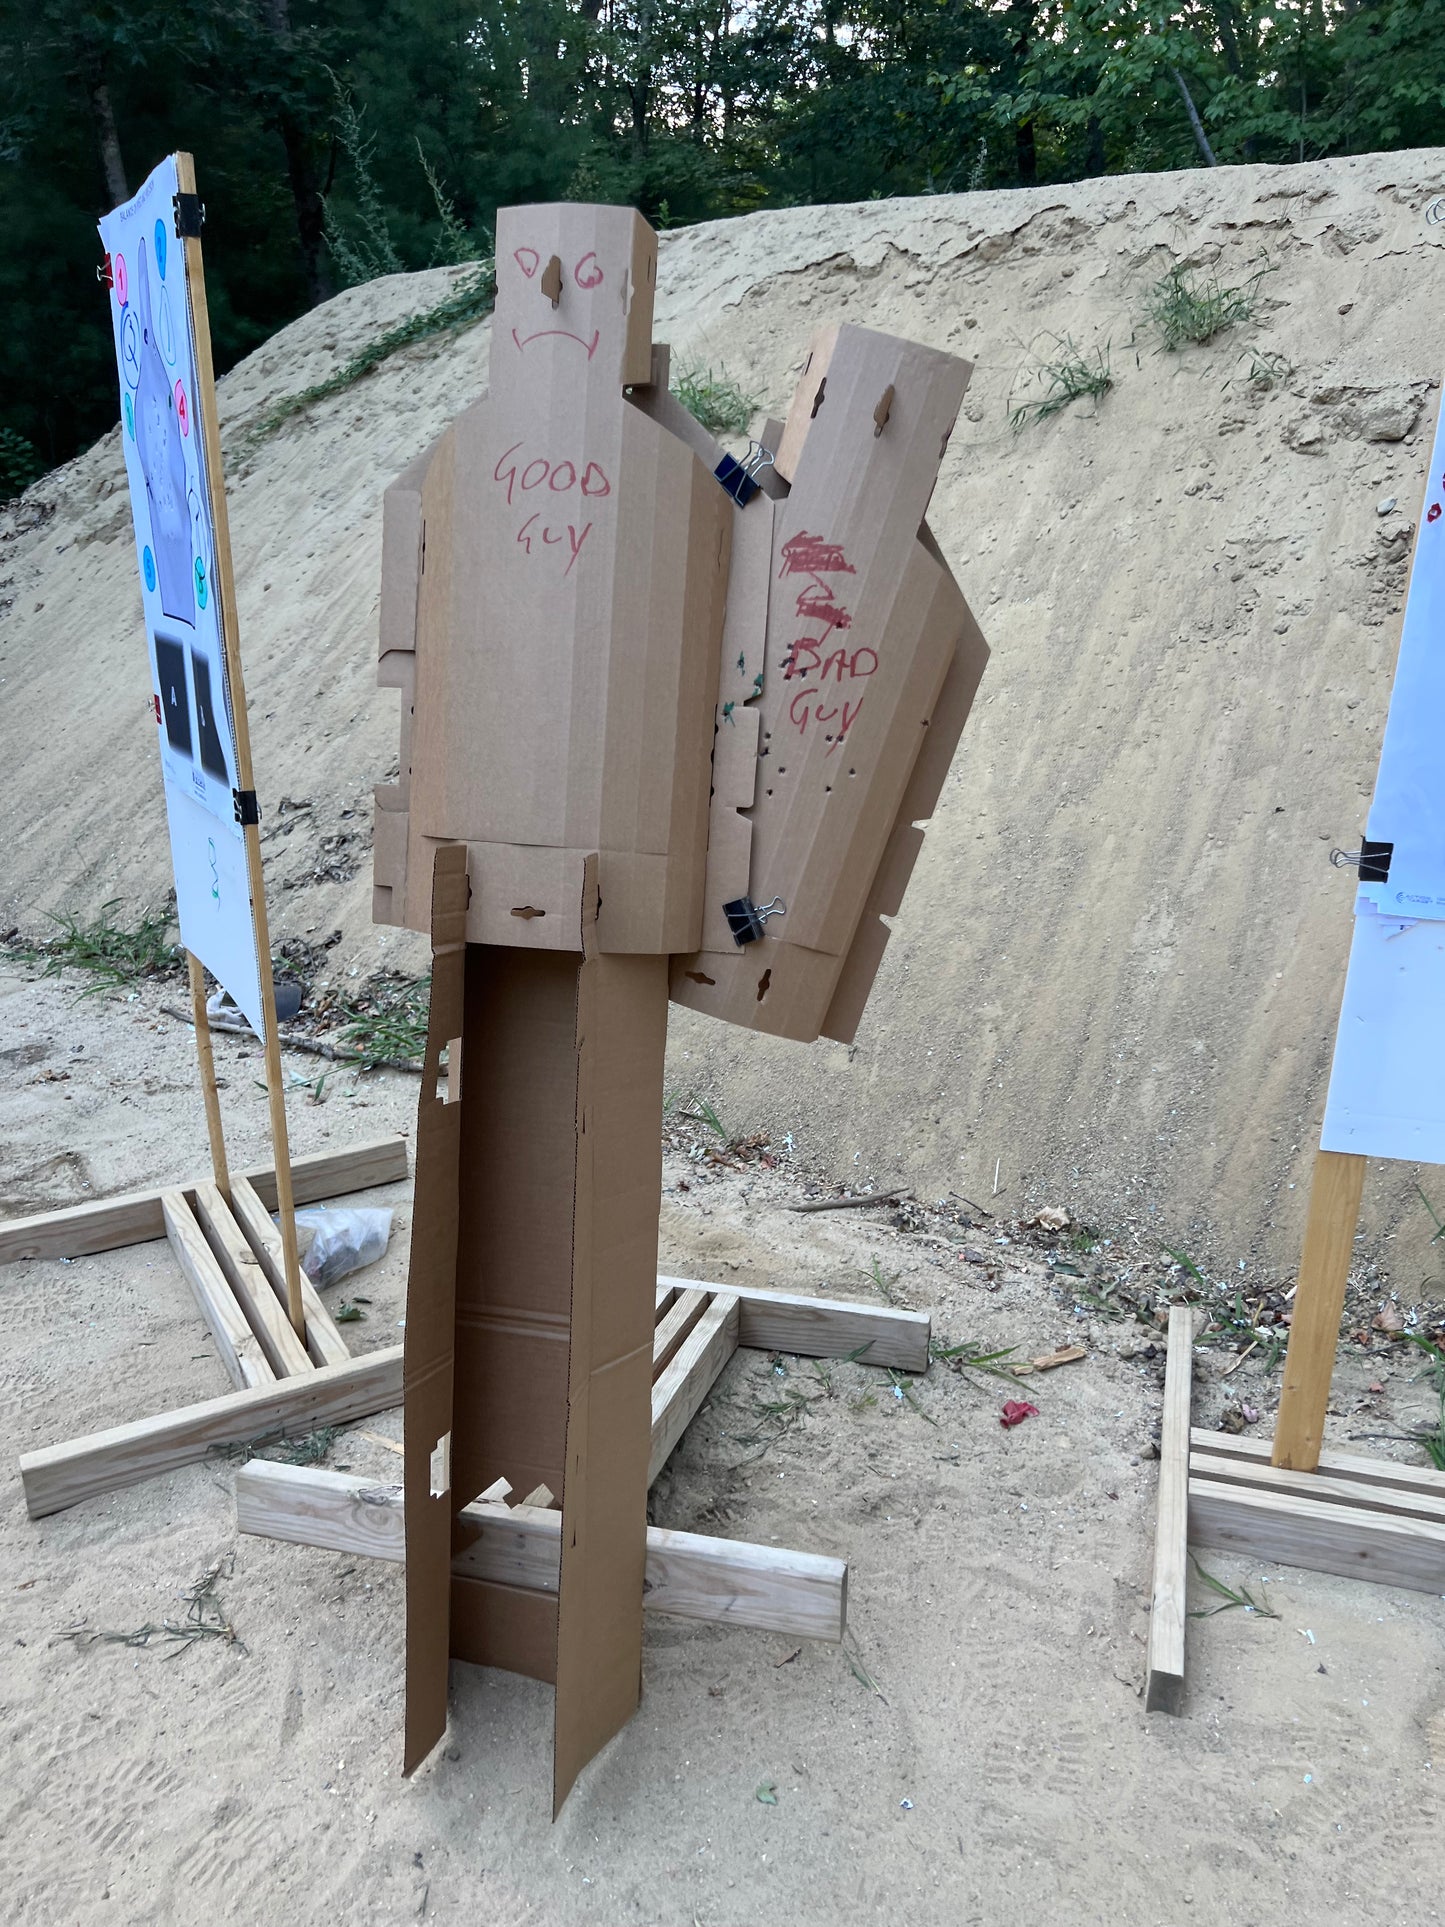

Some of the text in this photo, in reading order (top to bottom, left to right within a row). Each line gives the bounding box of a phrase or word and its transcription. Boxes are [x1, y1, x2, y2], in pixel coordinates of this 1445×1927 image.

[494, 441, 611, 505] GOOD
[517, 512, 592, 576] GUY
[784, 637, 878, 682] BAD
[170, 686, 178, 707] A
[789, 687, 863, 759] GUY
